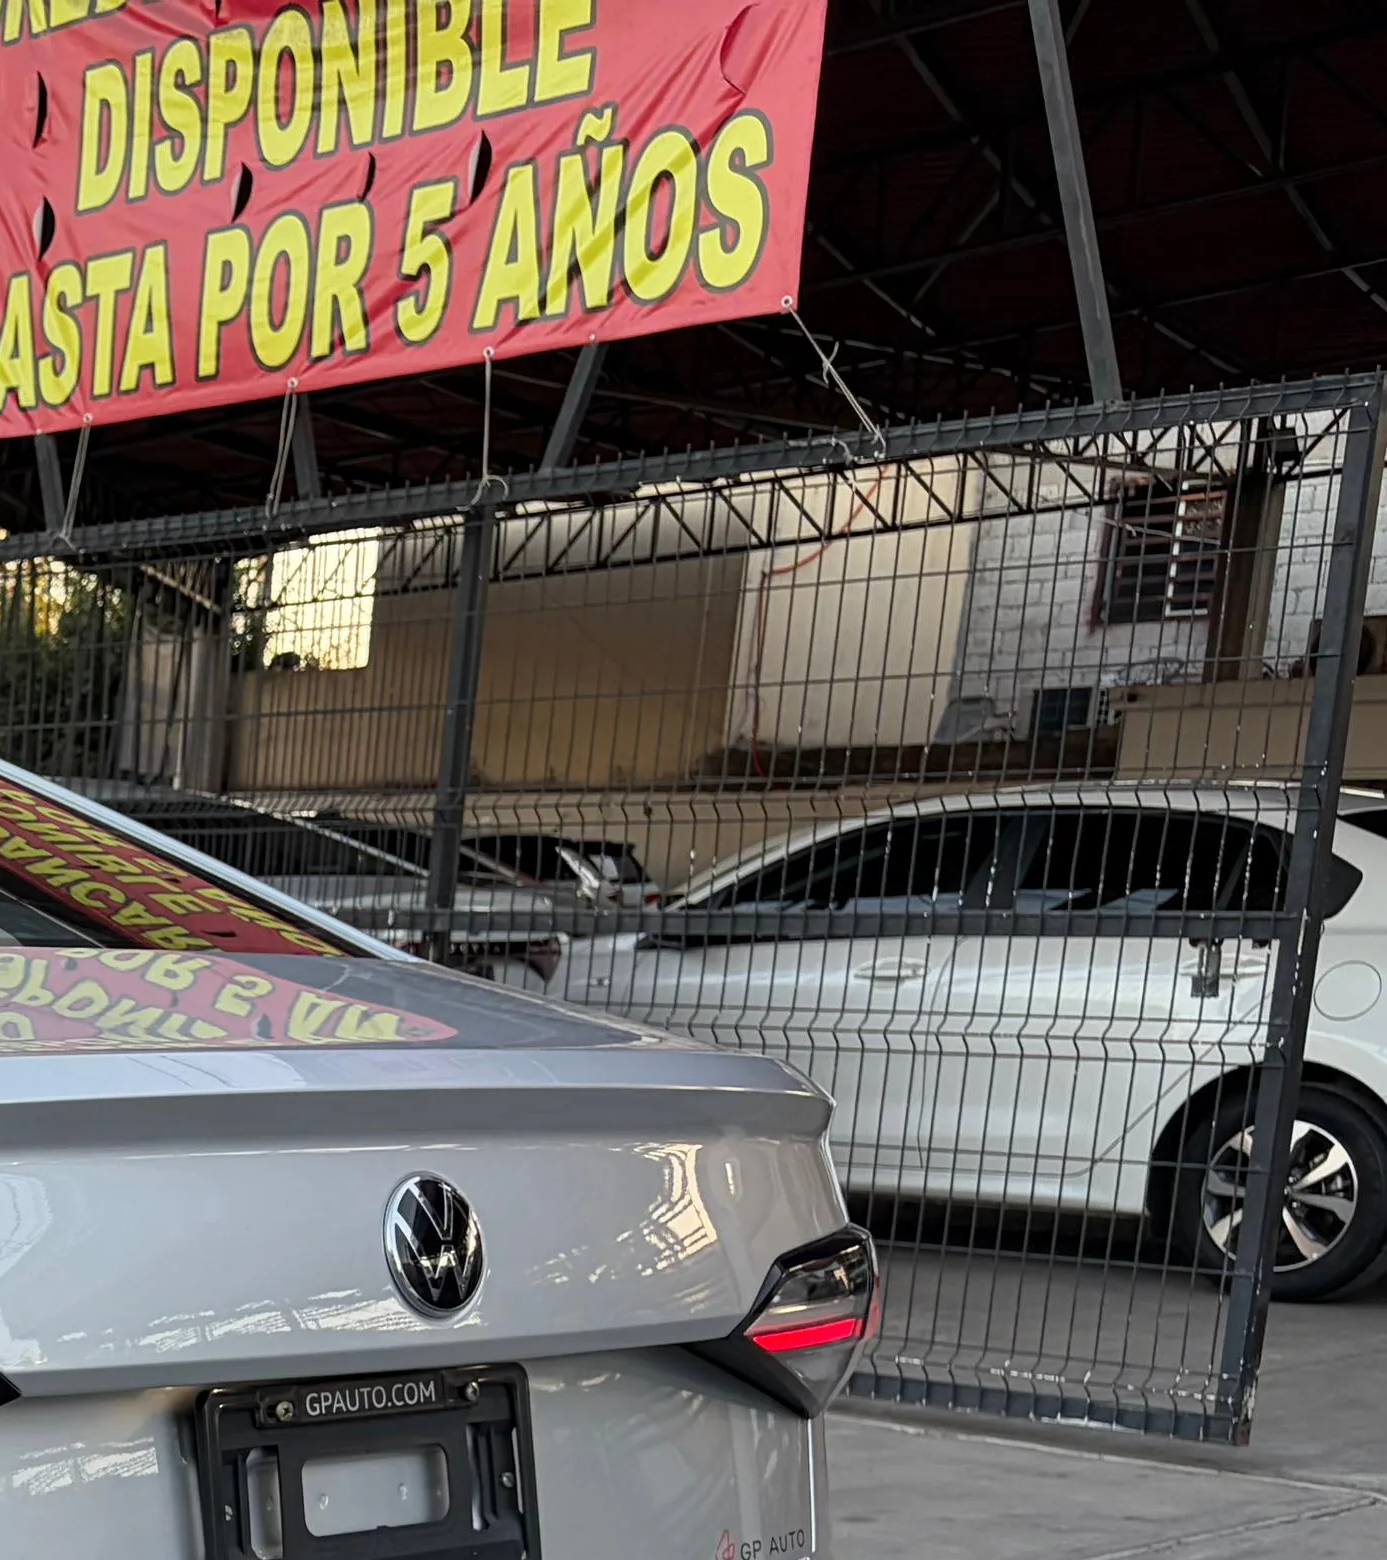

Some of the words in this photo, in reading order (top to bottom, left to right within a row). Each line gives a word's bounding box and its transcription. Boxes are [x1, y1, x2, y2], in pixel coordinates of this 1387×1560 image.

[76, 0, 593, 213] DISPONIBLE
[197, 199, 370, 381] POR
[396, 181, 457, 343] 5
[472, 107, 770, 331] AÑOS
[304, 1379, 437, 1418] GPAUTO.COM
[768, 1528, 806, 1557] AUTO
